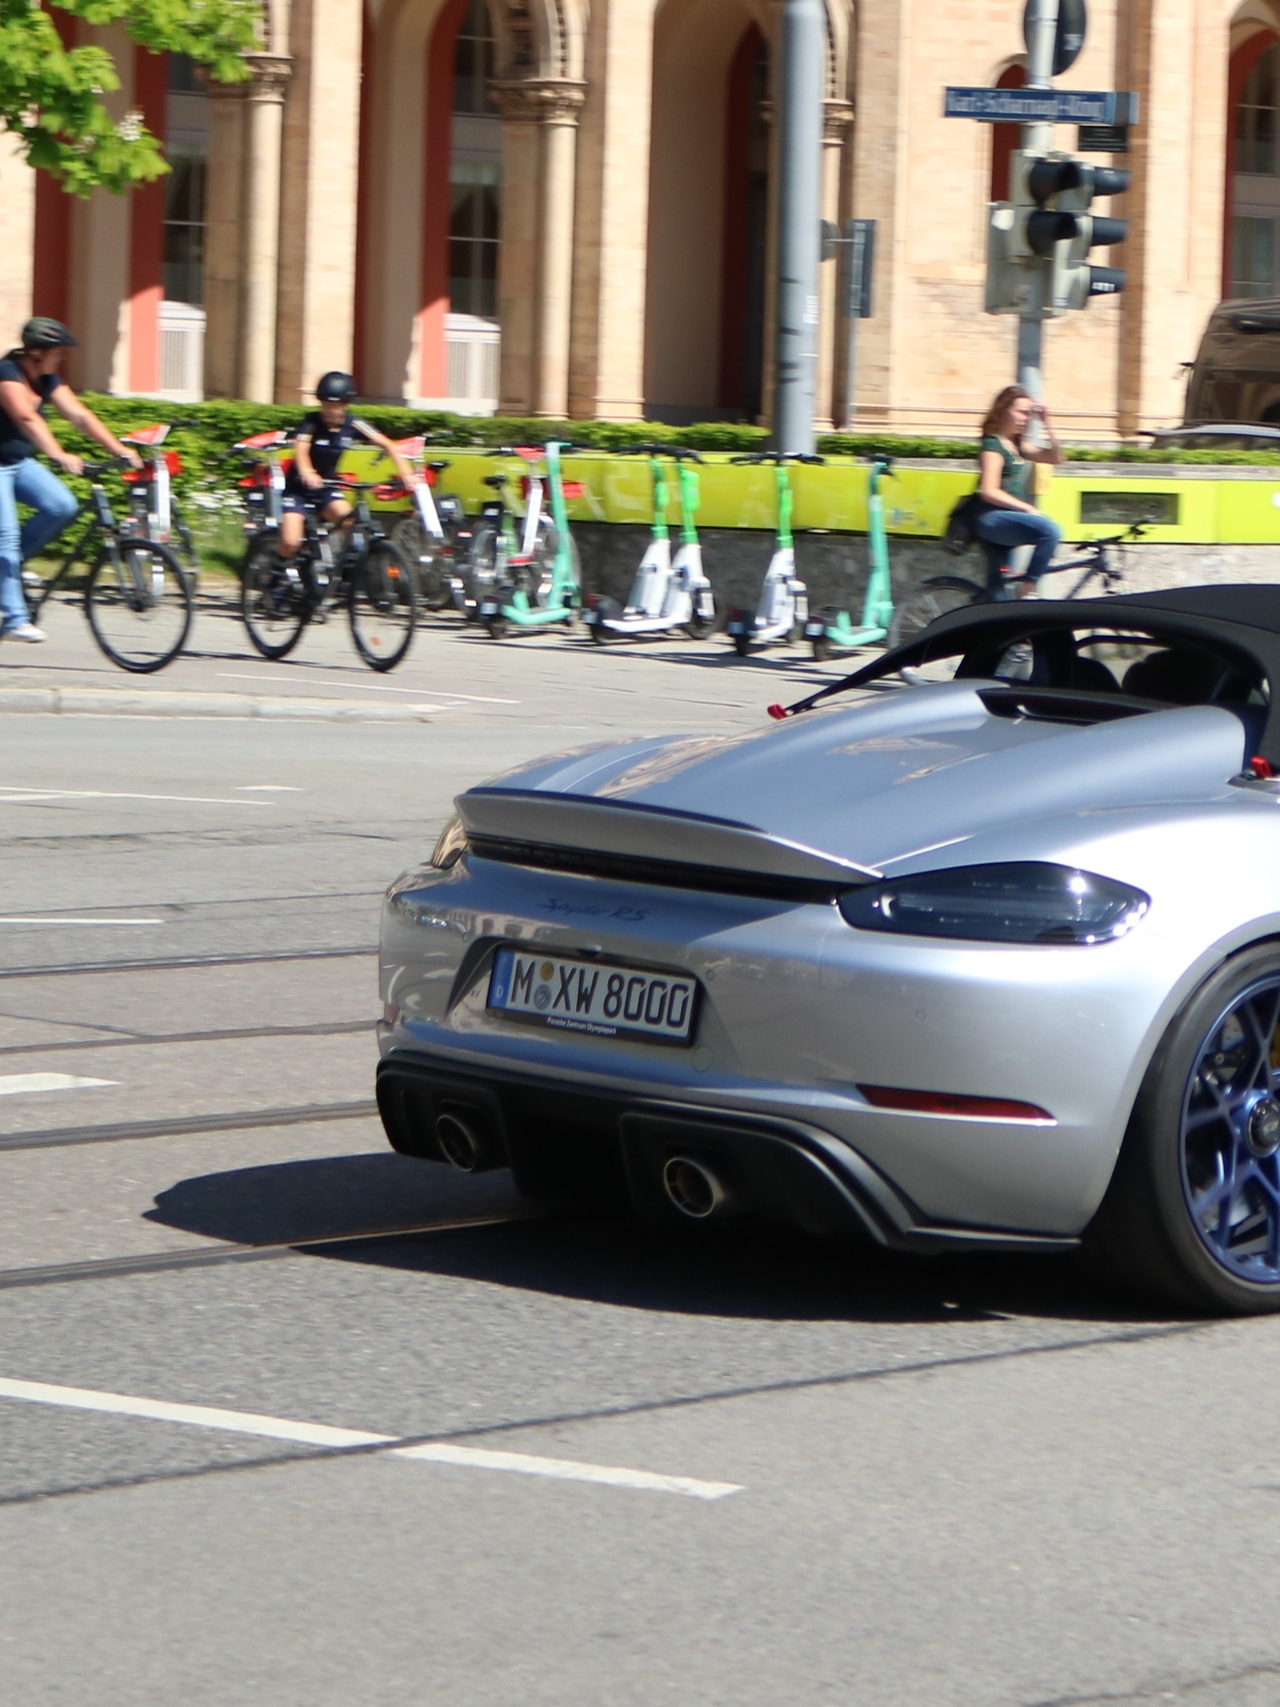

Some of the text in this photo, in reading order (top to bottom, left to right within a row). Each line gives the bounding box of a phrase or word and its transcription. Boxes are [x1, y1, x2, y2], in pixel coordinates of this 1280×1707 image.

[536, 898, 650, 921] Spyder RS
[496, 985, 504, 998] D
[511, 959, 690, 1029] M XW 8000
